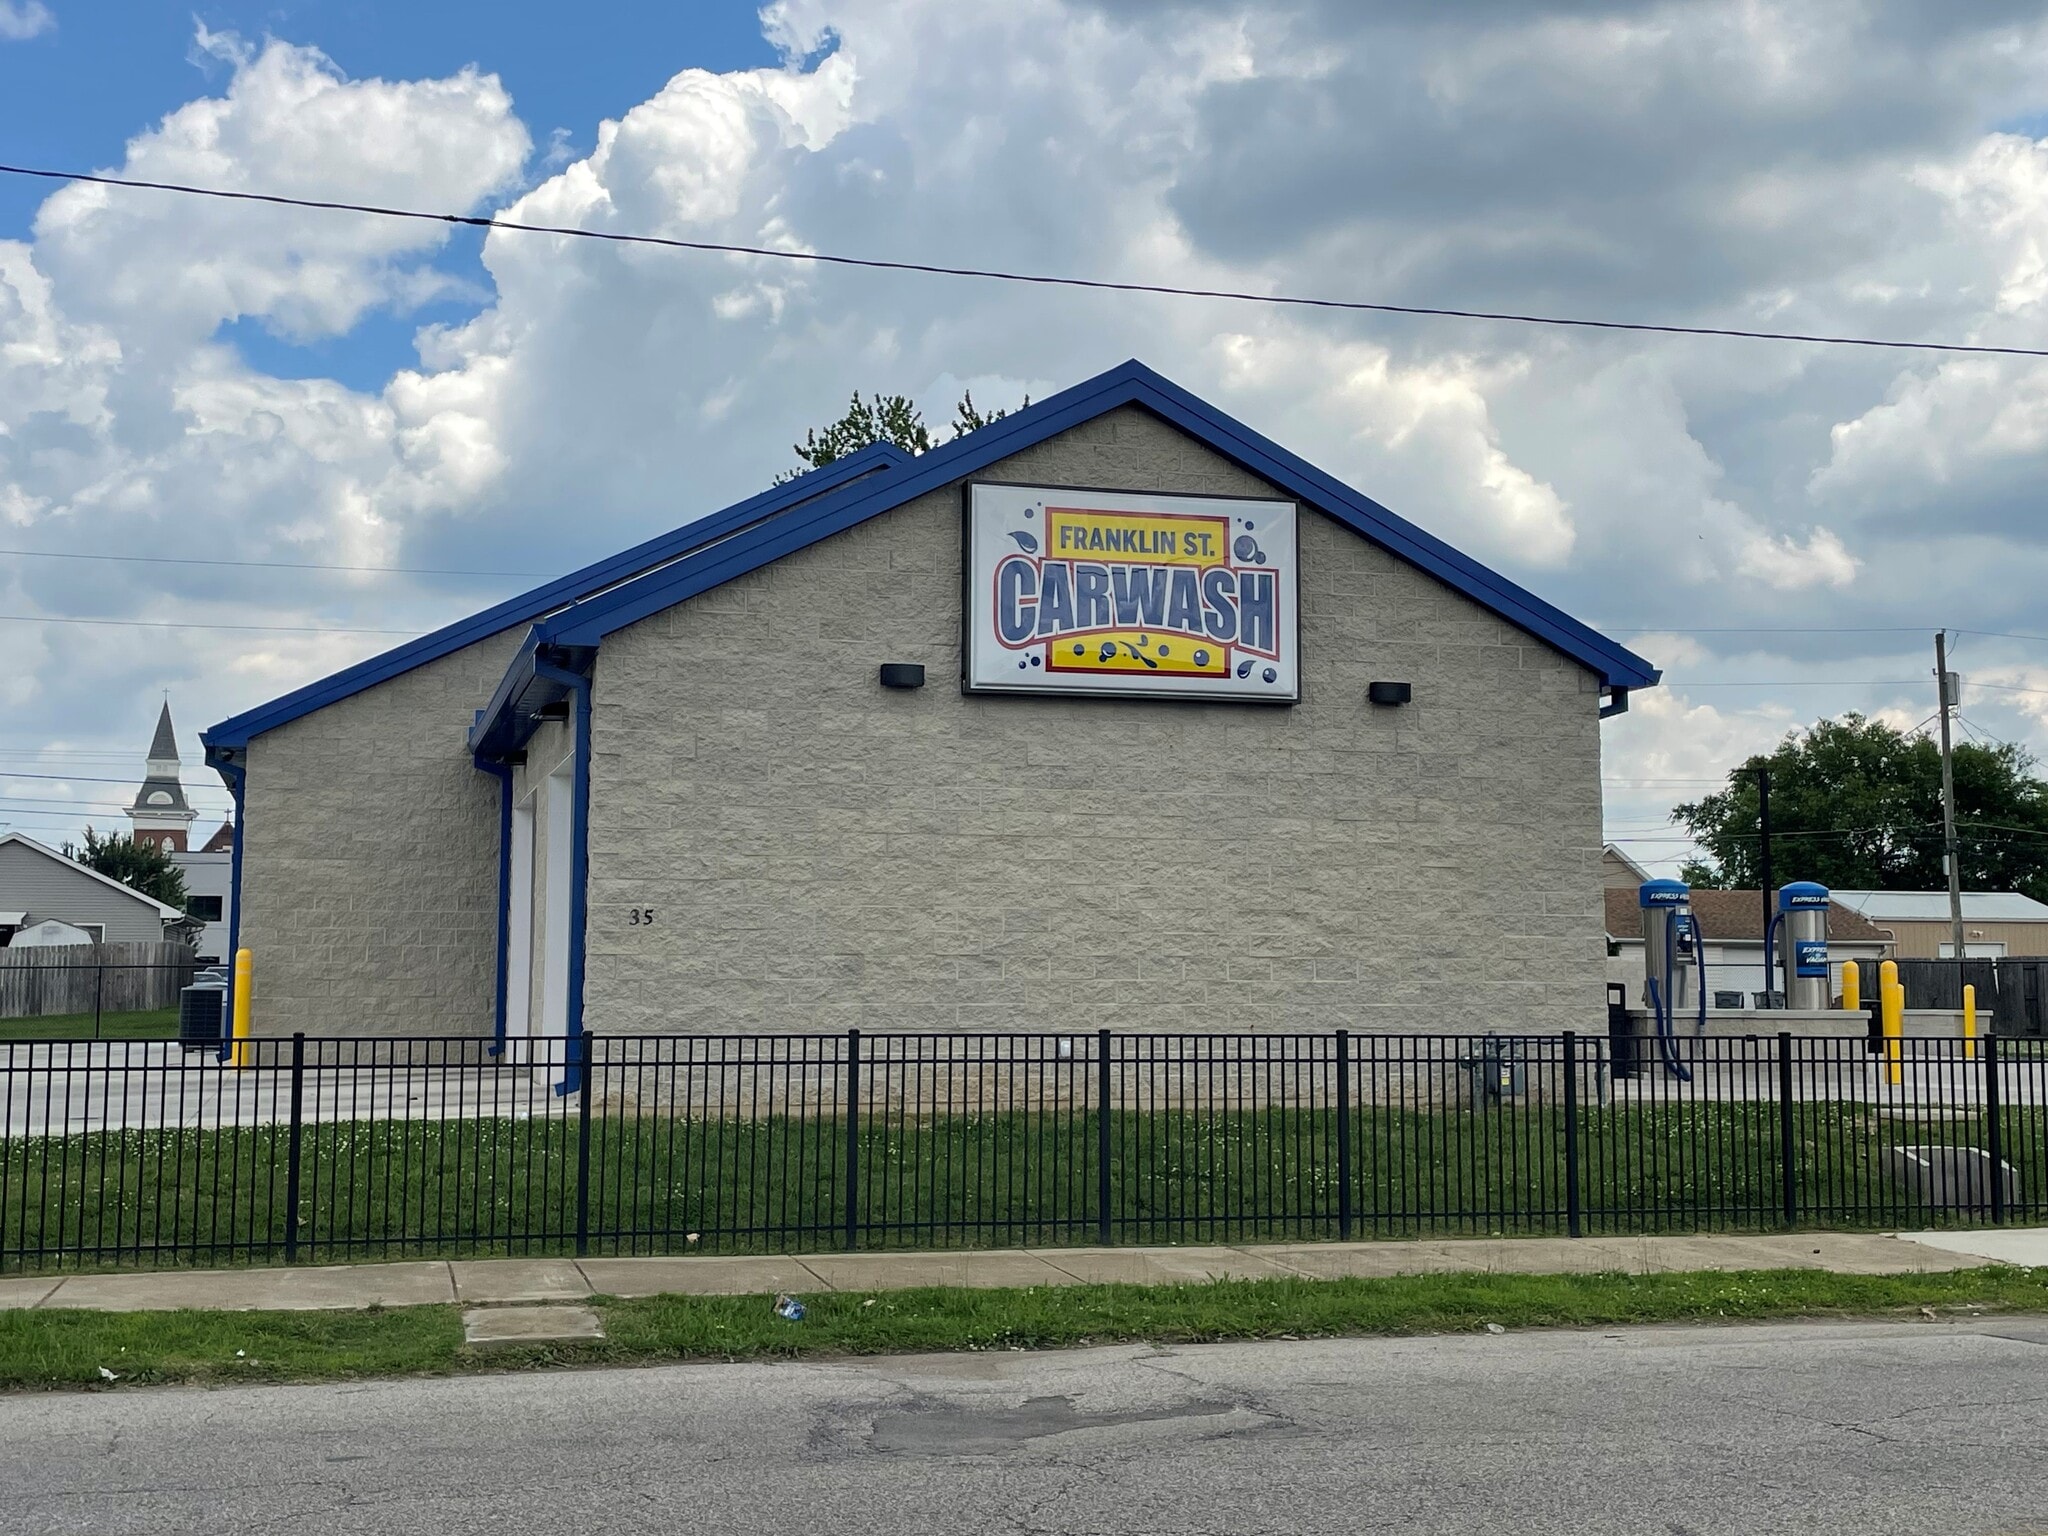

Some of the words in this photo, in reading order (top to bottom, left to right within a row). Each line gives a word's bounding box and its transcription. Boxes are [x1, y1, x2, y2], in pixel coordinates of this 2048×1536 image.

[1060, 525, 1176, 555] FRANKLIN
[1183, 532, 1216, 557] ST.
[998, 558, 1275, 654] CARWASH
[629, 908, 654, 926] 35
